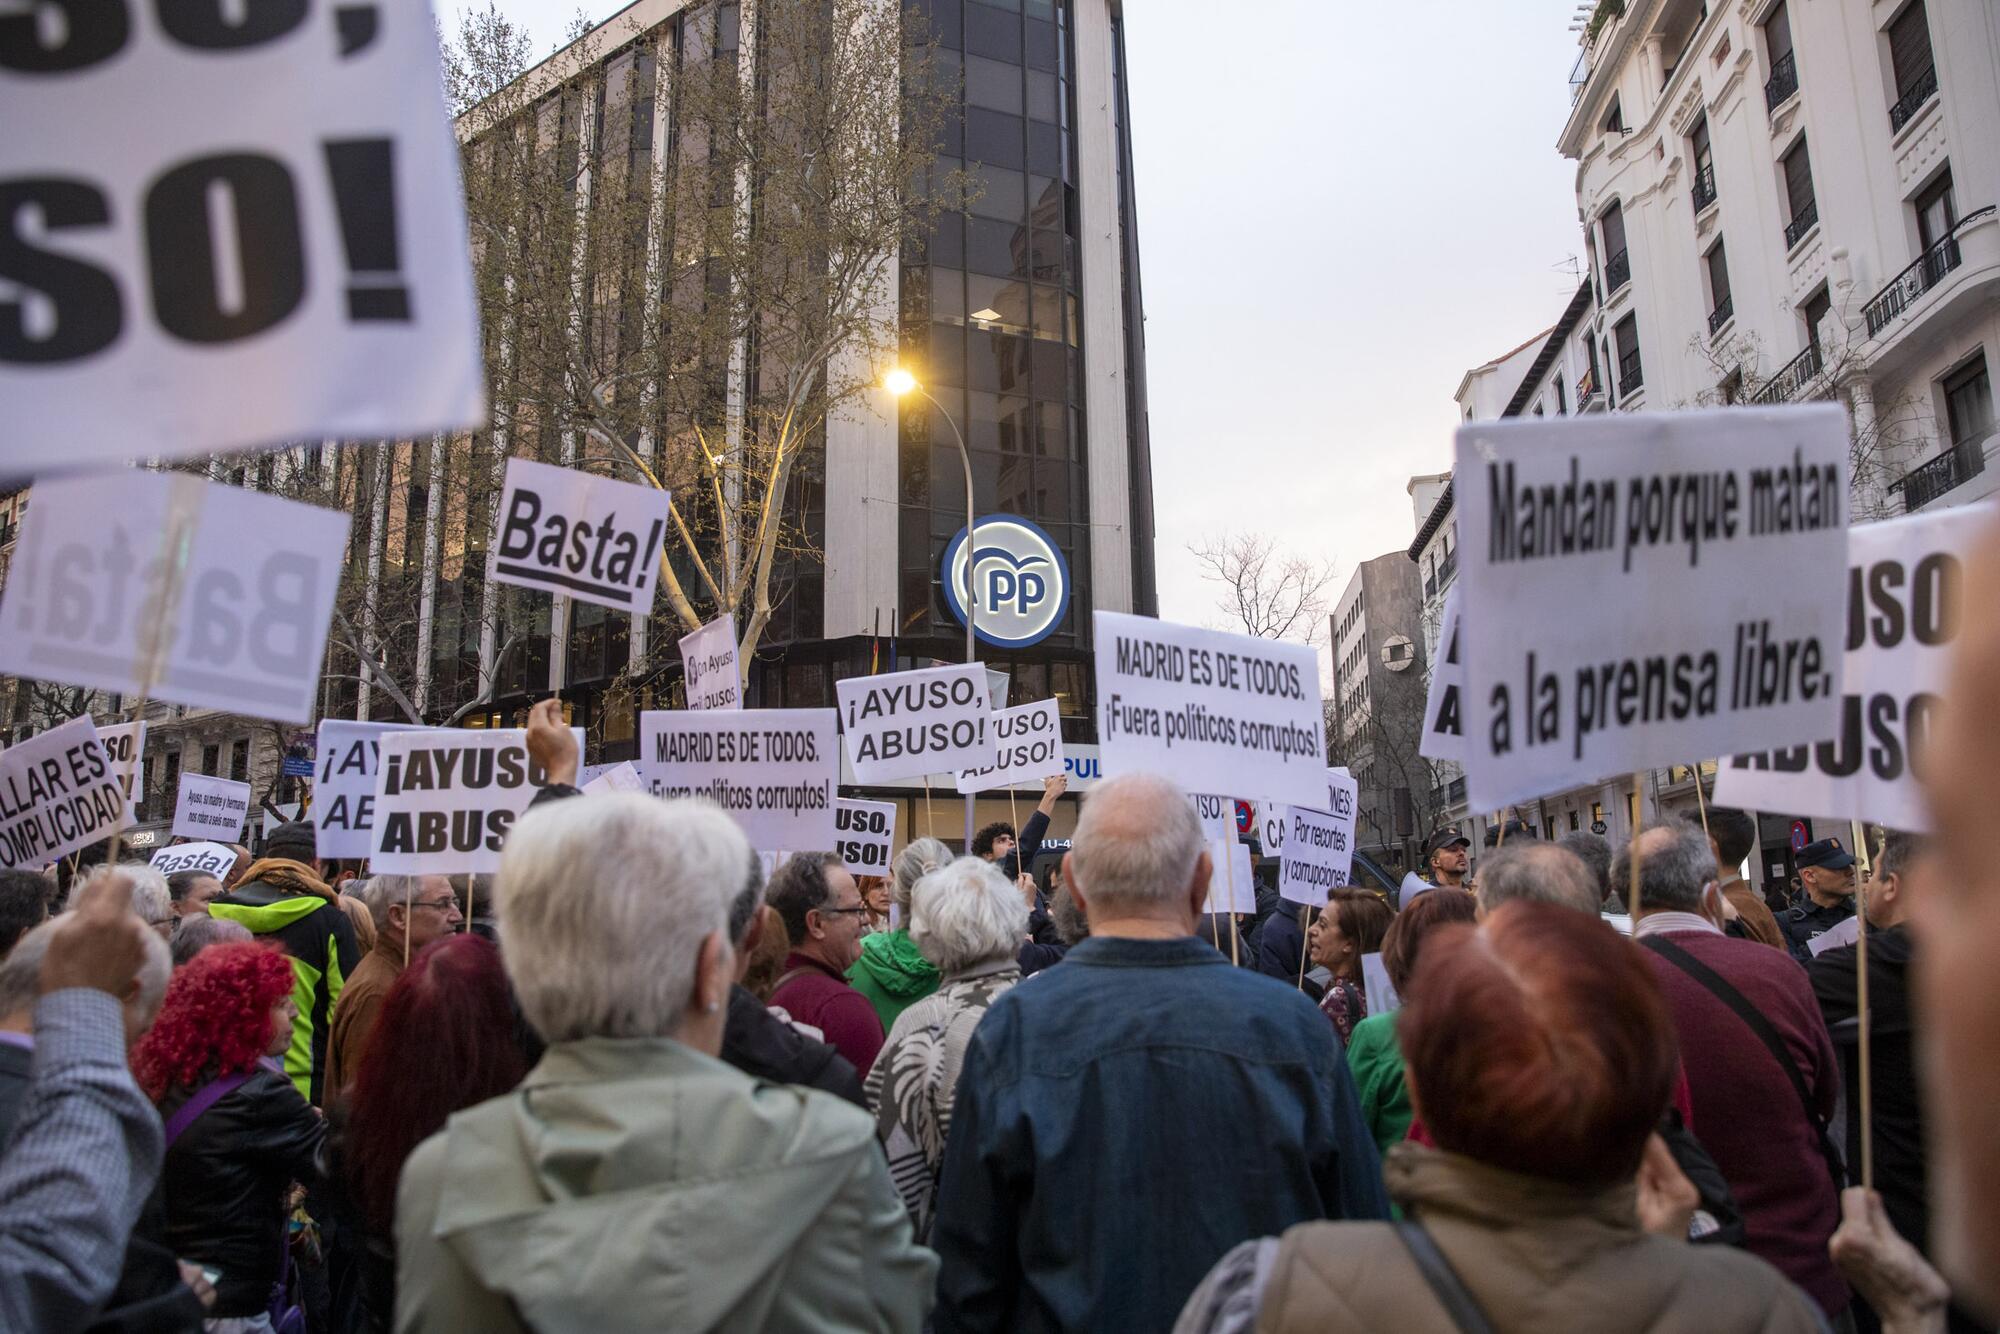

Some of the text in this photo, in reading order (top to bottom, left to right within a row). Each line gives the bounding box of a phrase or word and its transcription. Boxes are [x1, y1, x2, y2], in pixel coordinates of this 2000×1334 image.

[1488, 446, 1841, 573] Mandan porque matan
[499, 488, 663, 588] Basta!
[1116, 636, 1305, 701] MADRID ES DE TODOS.
[1490, 620, 1832, 760] a la prensa libre.
[849, 677, 982, 728] ¡AYUSO,
[993, 710, 1054, 739] USO,
[656, 731, 820, 762] MADRID ES DE TODOS.
[856, 717, 985, 763] ABUSO!
[1106, 694, 1320, 762] ¡Fuera políticos corruptos!
[66, 741, 105, 787] ES
[756, 779, 830, 817] corruptos!
[1294, 815, 1347, 852] Por recortes
[1284, 858, 1347, 891] y corrupciones
